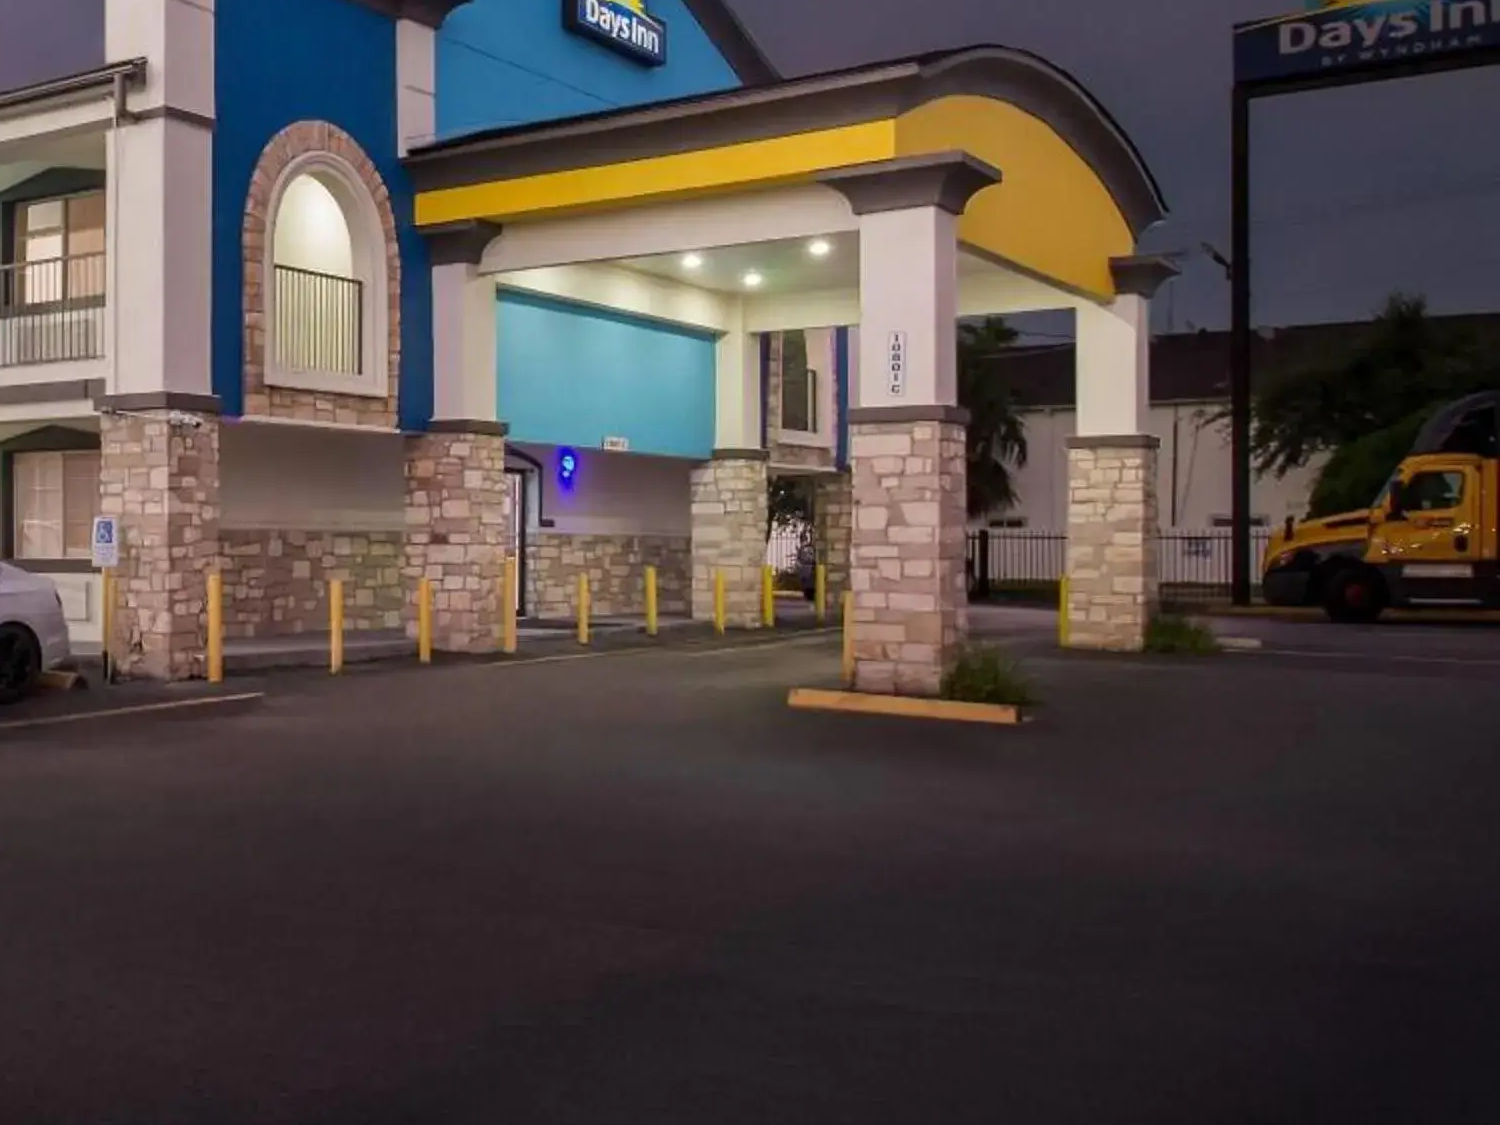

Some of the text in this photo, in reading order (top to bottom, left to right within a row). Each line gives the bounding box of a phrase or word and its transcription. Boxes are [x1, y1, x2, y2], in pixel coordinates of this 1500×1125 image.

[631, 18, 660, 55] Inn
[1278, 11, 1417, 55] Days
[1321, 33, 1483, 67] BY WYNDHAM
